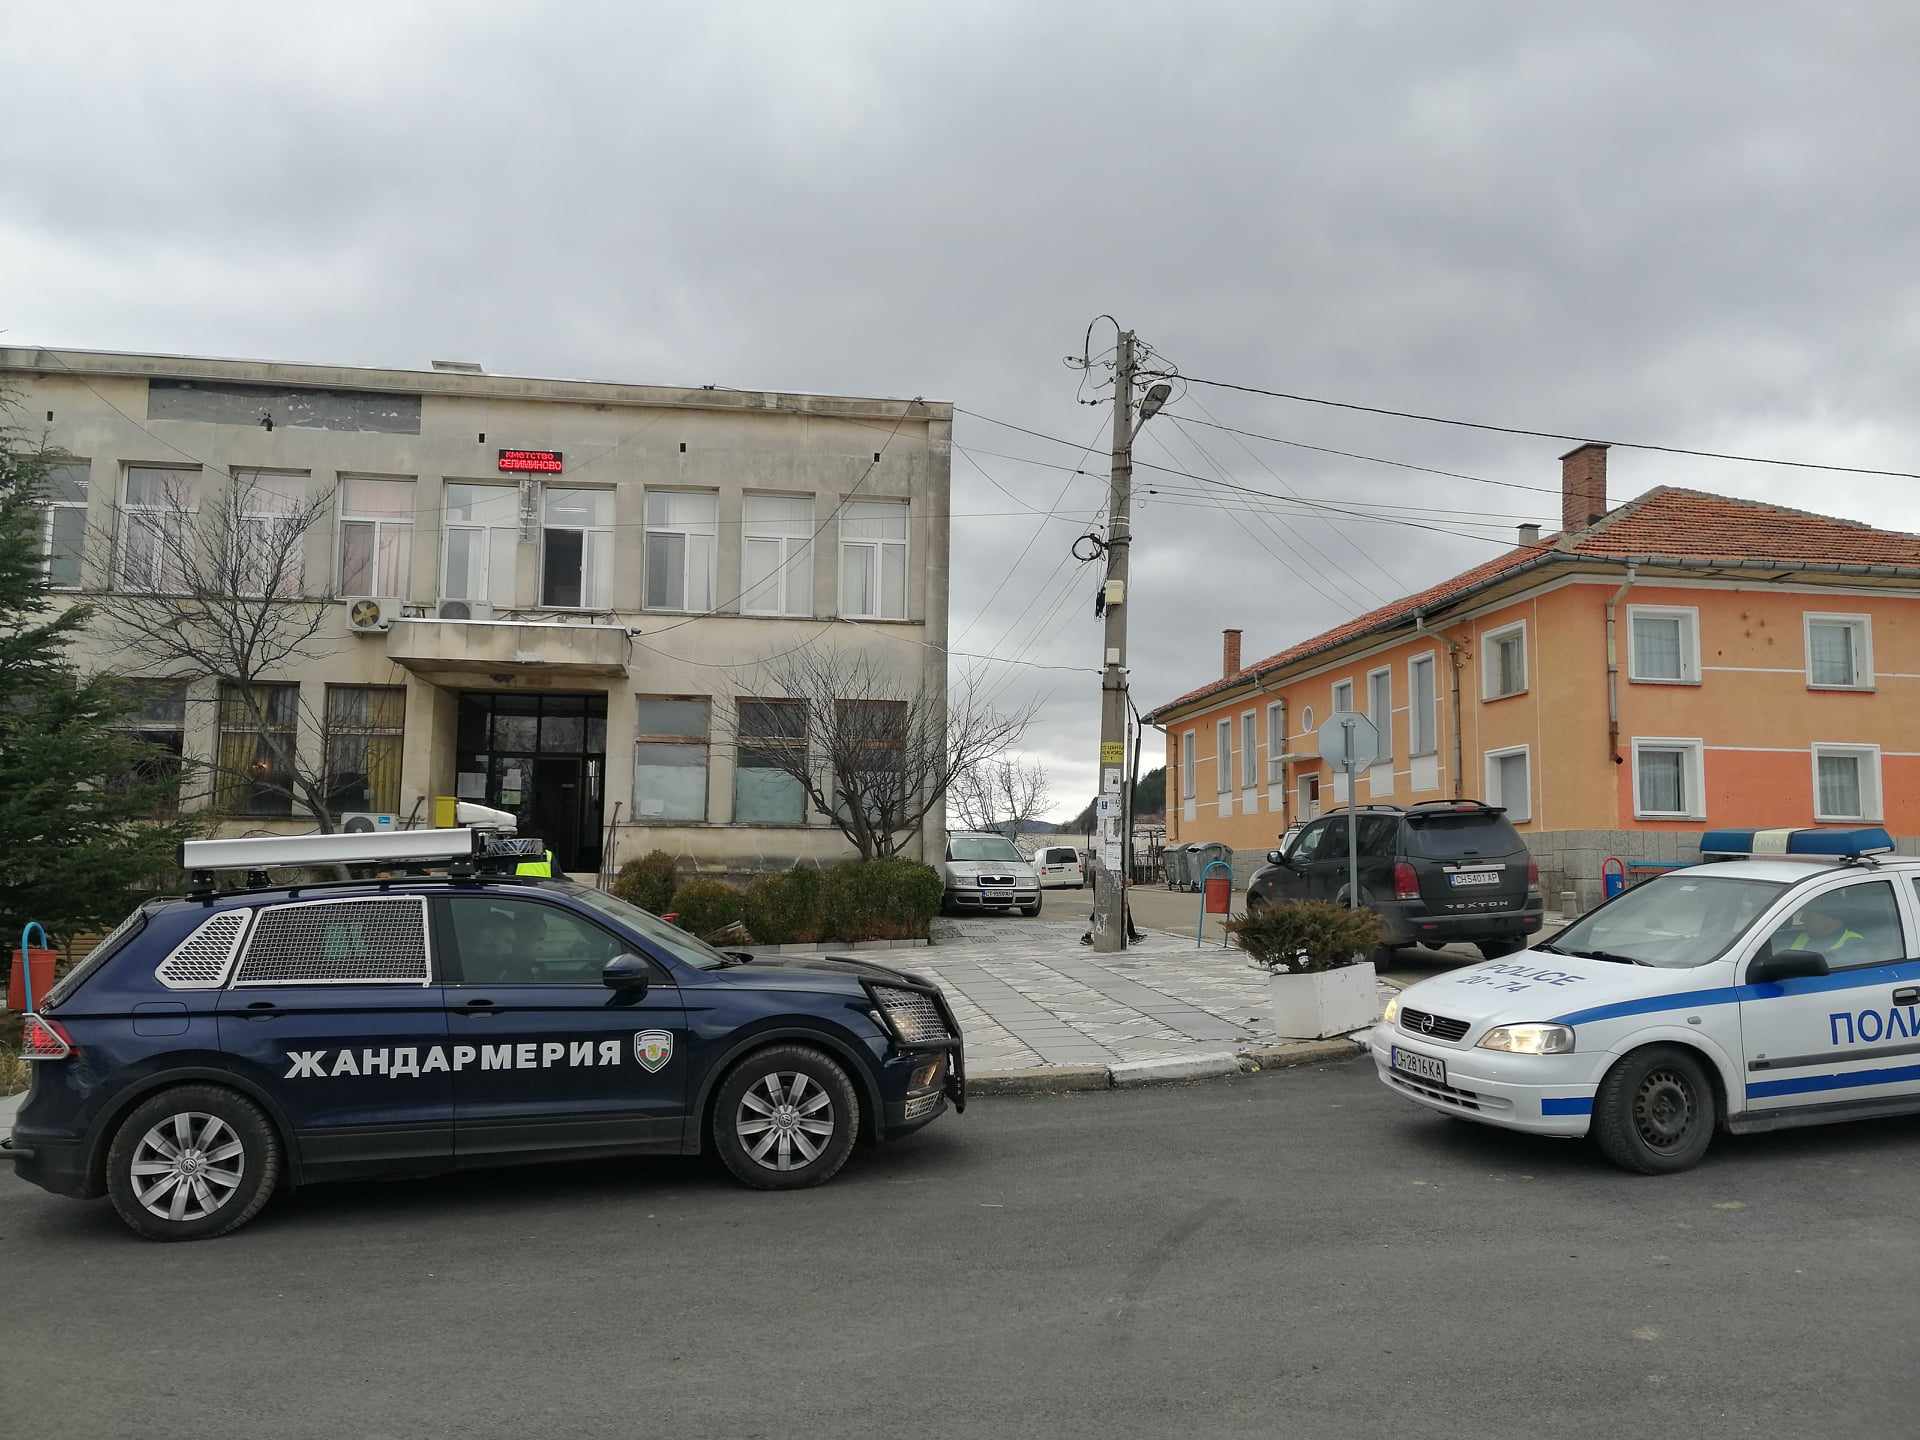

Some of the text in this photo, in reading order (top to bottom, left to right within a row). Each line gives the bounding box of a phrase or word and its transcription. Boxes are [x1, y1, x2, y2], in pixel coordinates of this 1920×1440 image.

[499, 459, 562, 470] СЕЛИМИНОВО
[1445, 901, 1508, 909] REXTON
[1477, 964, 1586, 986] POLICE
[284, 1040, 621, 1079] ЖАНДАРМЕРИЯ
